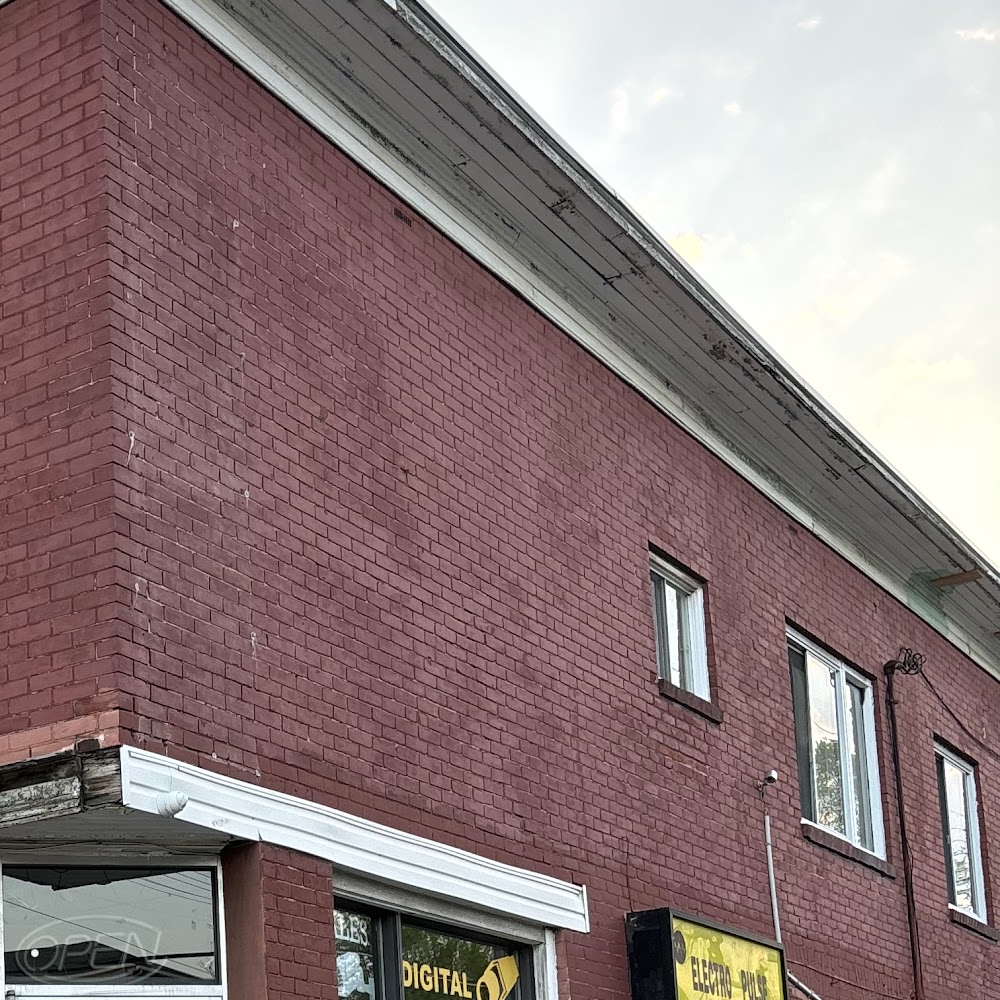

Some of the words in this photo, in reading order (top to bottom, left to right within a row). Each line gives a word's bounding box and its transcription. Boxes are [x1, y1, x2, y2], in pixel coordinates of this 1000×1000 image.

[24, 931, 161, 971] OPEN
[402, 960, 473, 999] DIGITAL
[691, 955, 731, 1000] ELECTRO
